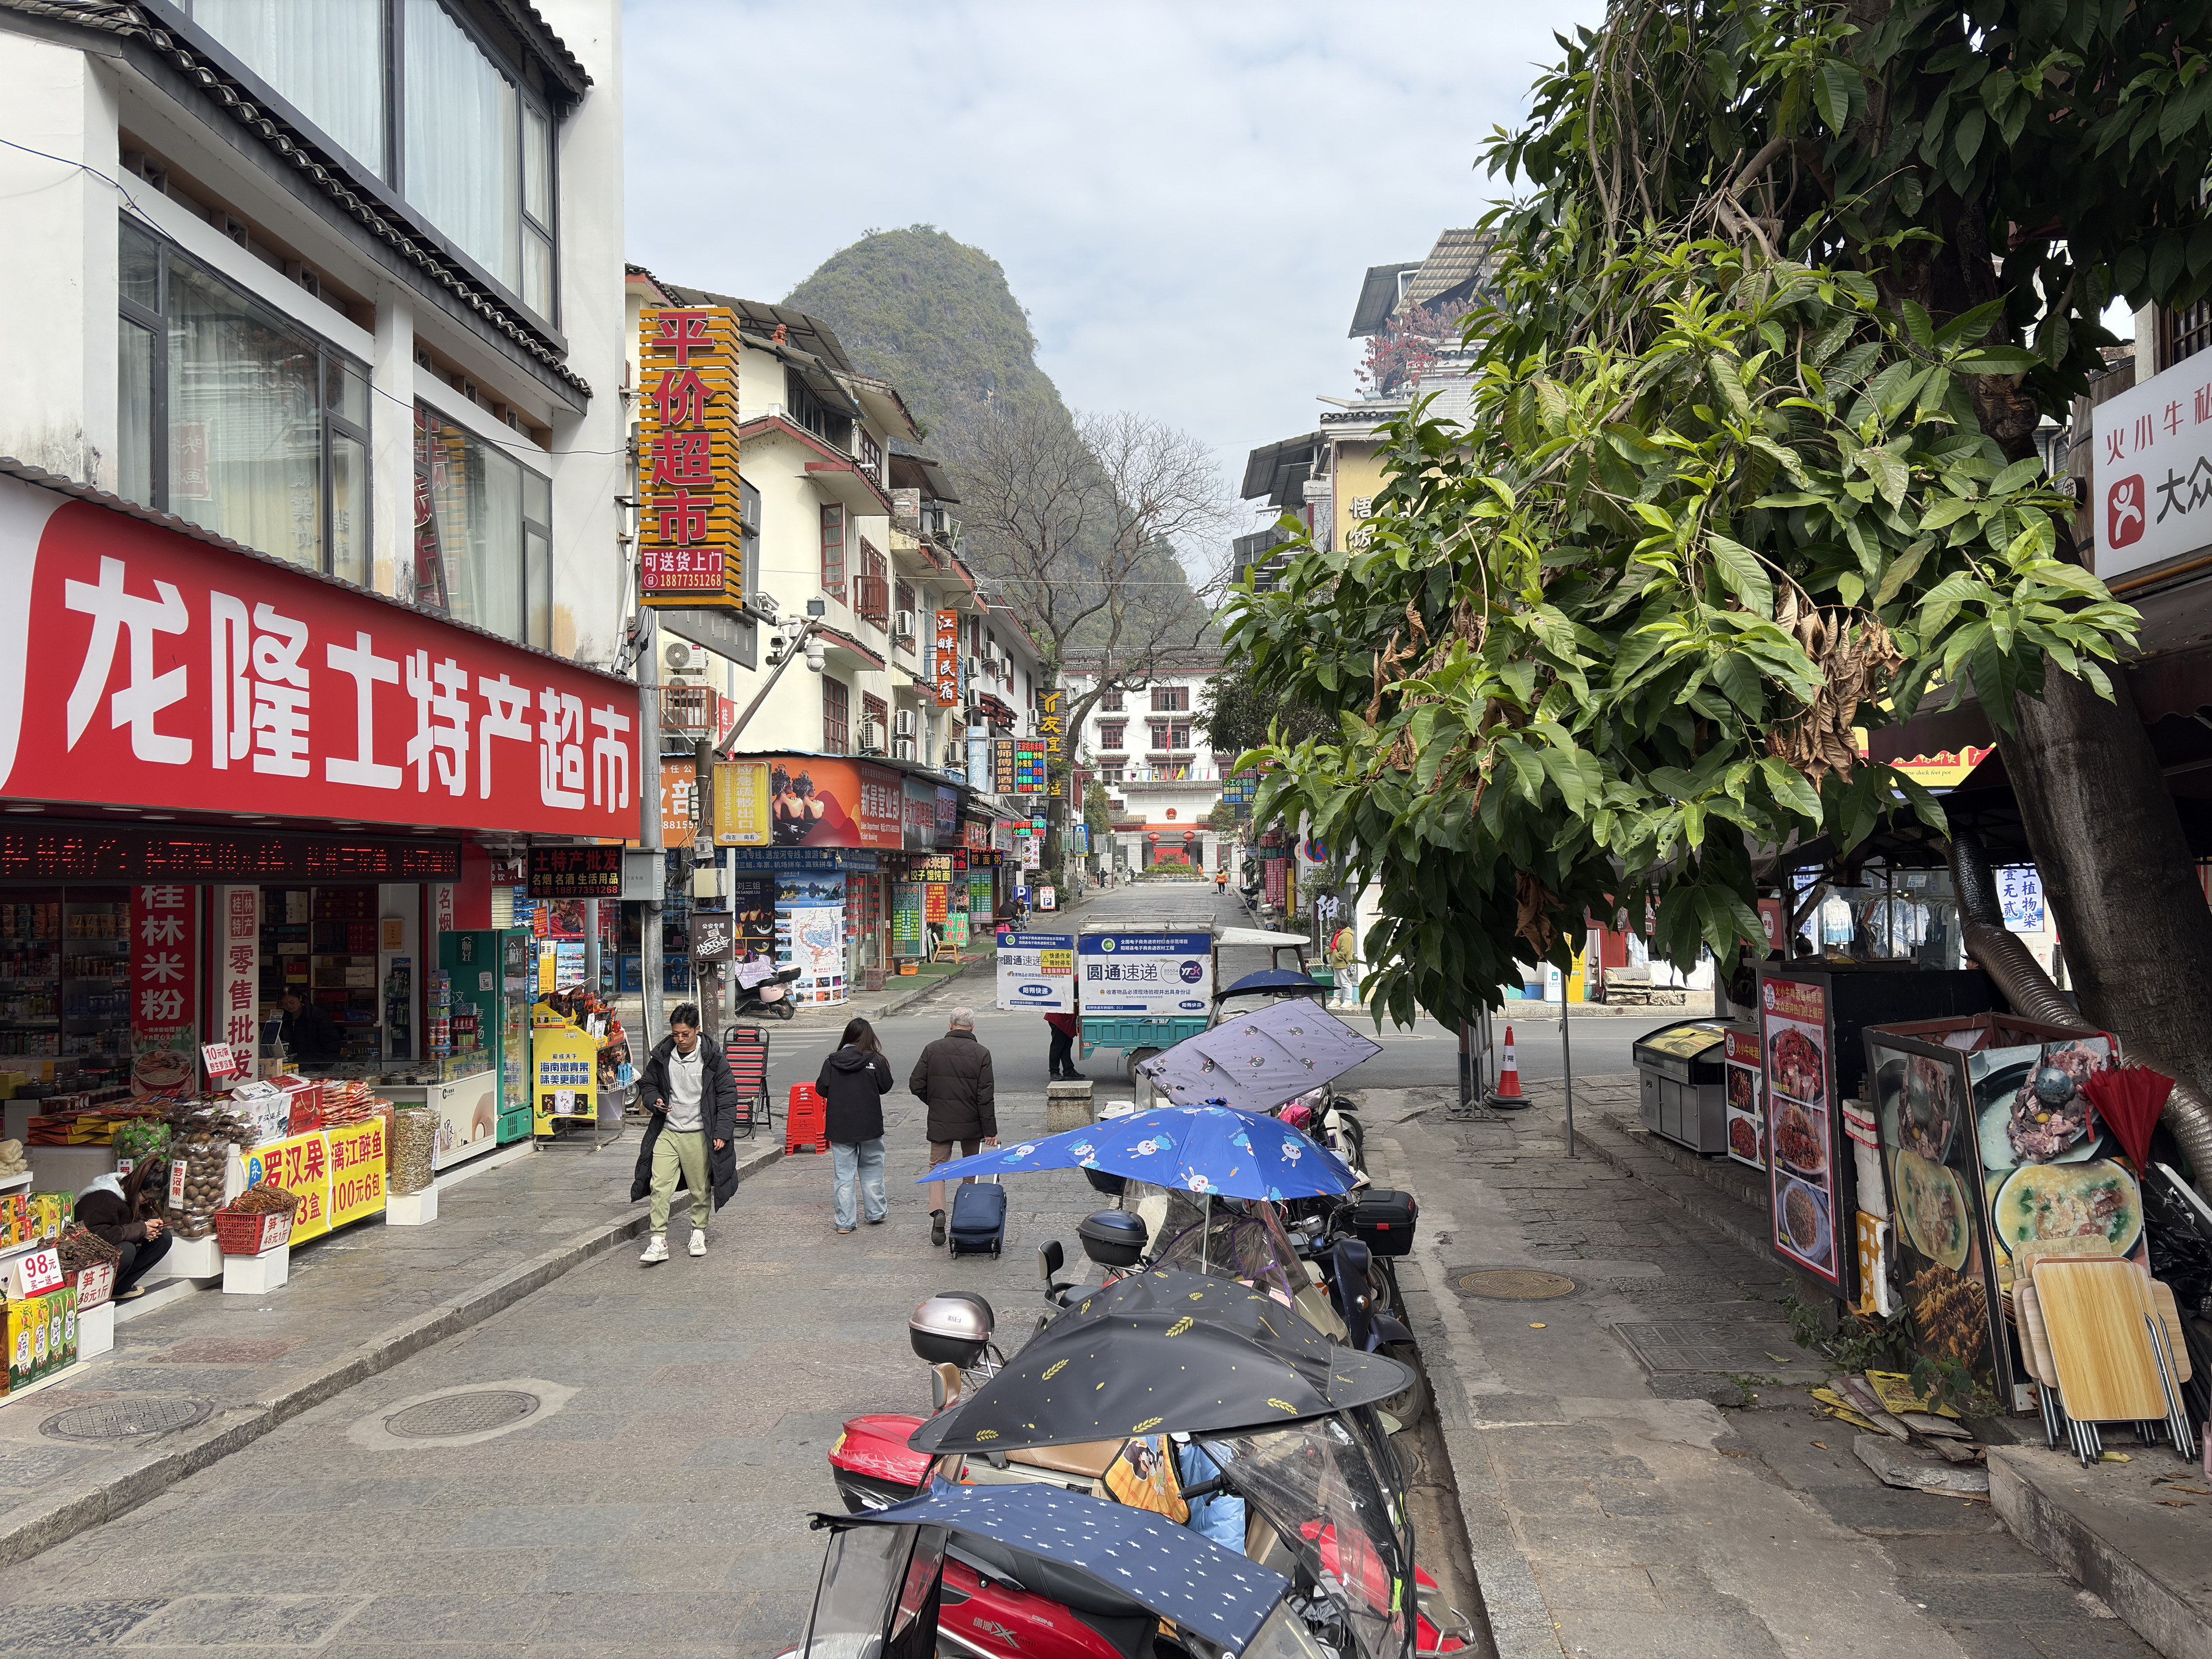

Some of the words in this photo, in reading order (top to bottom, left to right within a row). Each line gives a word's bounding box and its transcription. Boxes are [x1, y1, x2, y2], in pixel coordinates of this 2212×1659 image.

[651, 311, 717, 546] 平价超市
[644, 552, 722, 572] 可送货上门
[660, 574, 721, 587] 18877351268
[937, 615, 956, 700] 江畔民宿
[65, 555, 630, 814] 龙隆土特产超市
[1017, 742, 1044, 751] 正宗桂林米粉
[997, 742, 1012, 792] 雷师傅啤酒鱼
[861, 781, 900, 821] 新景营业部
[725, 812, 733, 827] exit
[867, 822, 879, 831] Department
[868, 833, 878, 842] Booking
[534, 849, 619, 872] 土特产批发
[911, 857, 950, 869] 桂林米粉
[972, 854, 1001, 865] 粉面粥
[533, 874, 552, 885] 名烟
[555, 874, 575, 885] 名酒
[578, 873, 618, 885] 生活用品
[911, 870, 925, 881] 饺子
[927, 870, 950, 881] 馄饨面
[737, 881, 760, 890] 刘三姐
[894, 885, 918, 894] 营养快餐
[1019, 888, 1026, 896] P
[232, 895, 253, 912] 桂林
[1316, 895, 1339, 921] 阳
[232, 917, 253, 935] 特产
[945, 919, 965, 929] 今日
[945, 931, 966, 941] 有房
[141, 885, 185, 1021] 桂林米粉
[1004, 955, 1041, 966] 圆通速递
[1087, 963, 1157, 981] 圆通速递
[1776, 985, 1823, 1004] 火小牛啤酒鱼私房菜
[228, 945, 254, 1082] 零售批发
[1776, 1001, 1823, 1020] 大众点评热门榜上餐厅
[206, 1047, 229, 1061] 10元/袋
[209, 1059, 234, 1072] 野生罗汉果
[540, 1062, 589, 1073] 海南嫩青果
[540, 1074, 589, 1085] 味美更耐嚼
[331, 1130, 384, 1173] 漓江醉鱼
[264, 1139, 325, 1189] 罗汉果
[173, 1167, 183, 1196] 罗汉果
[332, 1172, 380, 1214] 100元6包
[268, 1214, 291, 1233] 笋干
[264, 1230, 288, 1245] 48元1斤
[25, 1254, 57, 1278] 98元
[30, 1274, 60, 1290] 买一送一
[82, 1266, 111, 1291] 笋干
